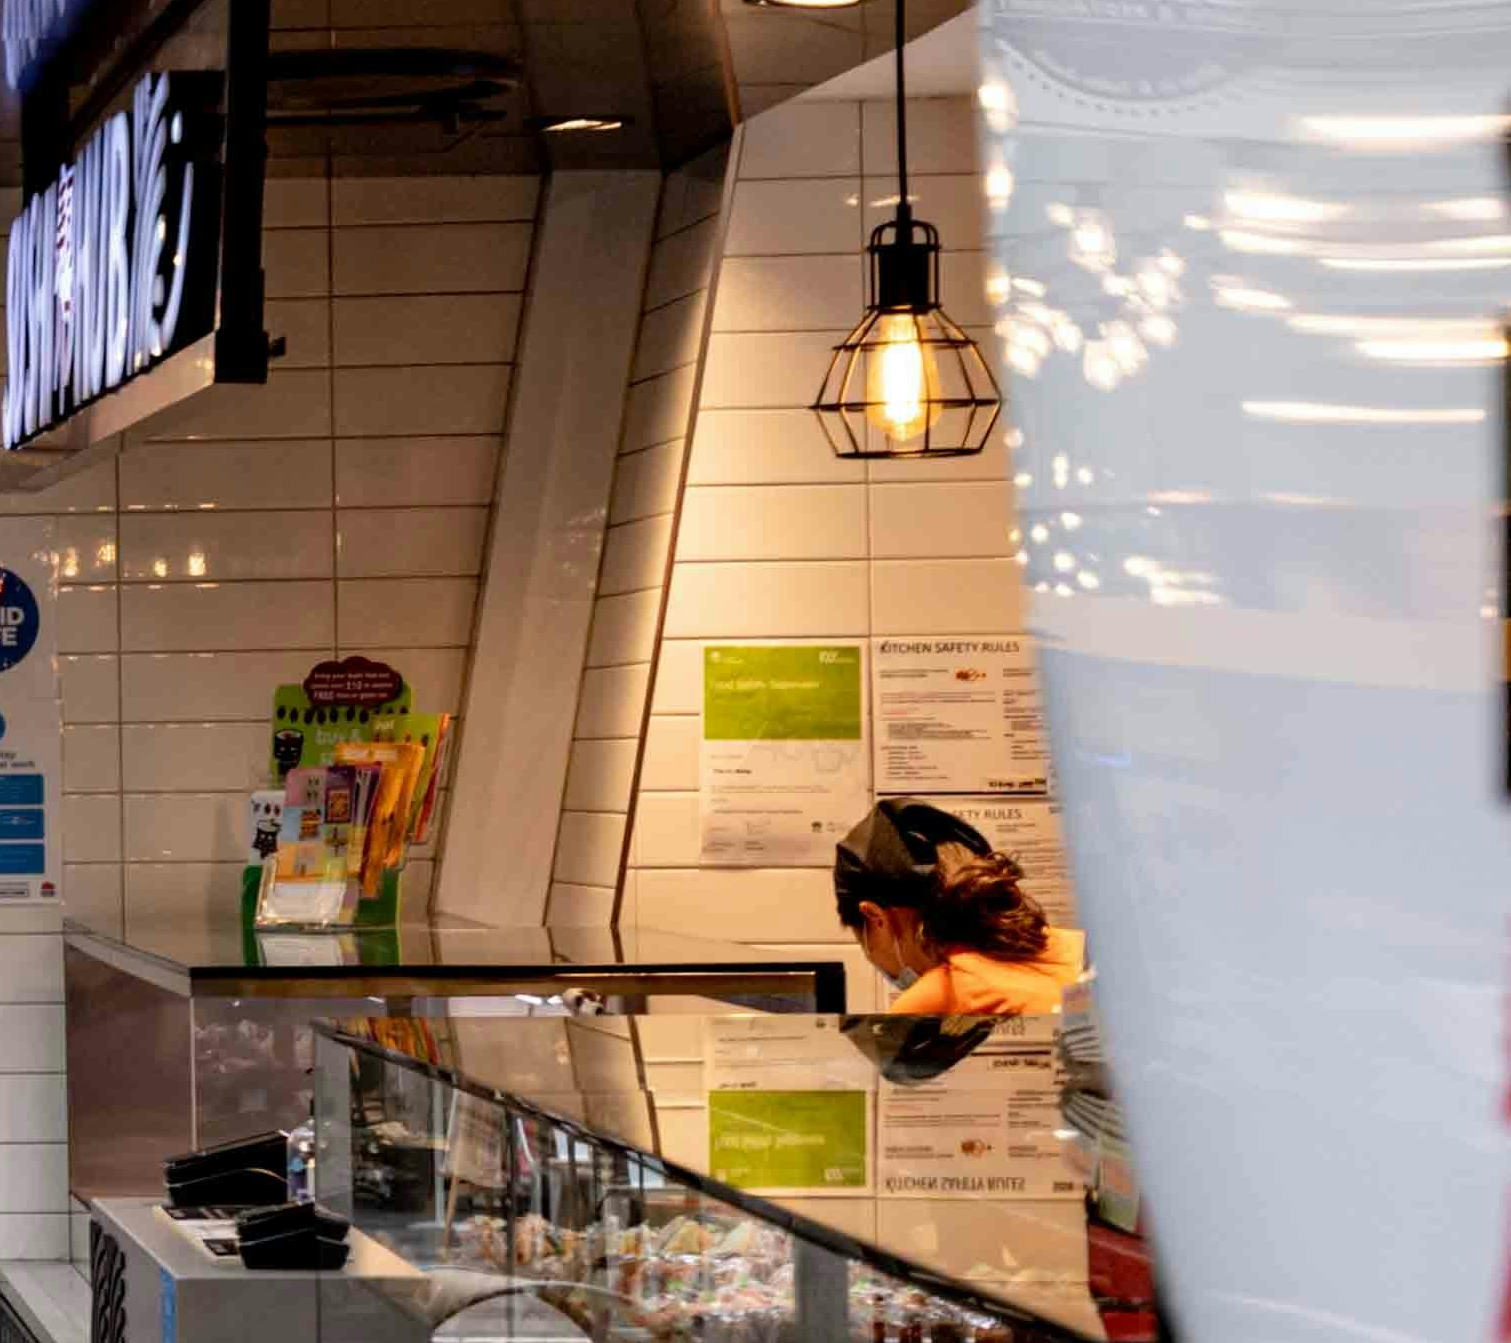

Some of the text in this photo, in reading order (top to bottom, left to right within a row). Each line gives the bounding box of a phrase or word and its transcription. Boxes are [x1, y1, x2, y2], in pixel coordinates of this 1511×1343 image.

[879, 640, 1020, 655] KITCHEN SAFETY RULES
